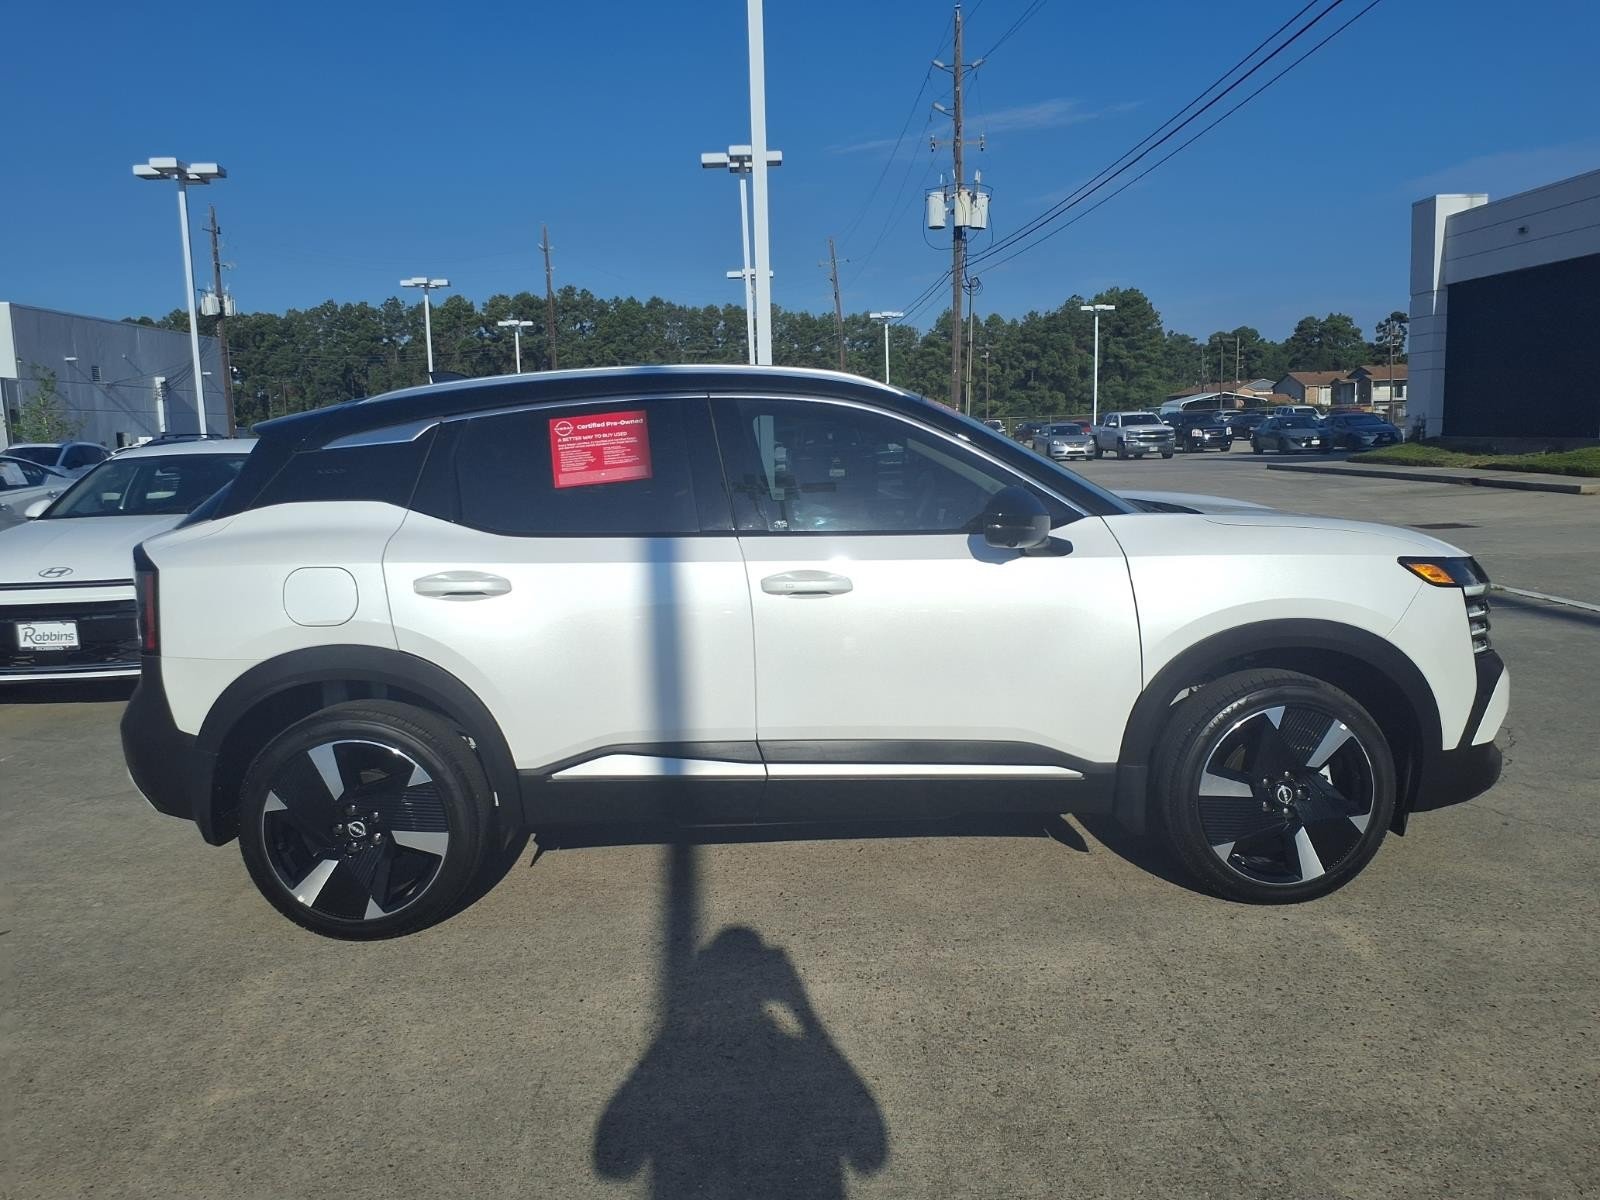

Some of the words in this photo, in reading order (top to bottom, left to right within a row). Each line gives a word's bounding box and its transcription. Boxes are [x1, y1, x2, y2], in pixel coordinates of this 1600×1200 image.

[577, 422, 605, 430] Certified
[606, 418, 643, 426] Pre-Owned
[22, 626, 74, 645] Robbins
